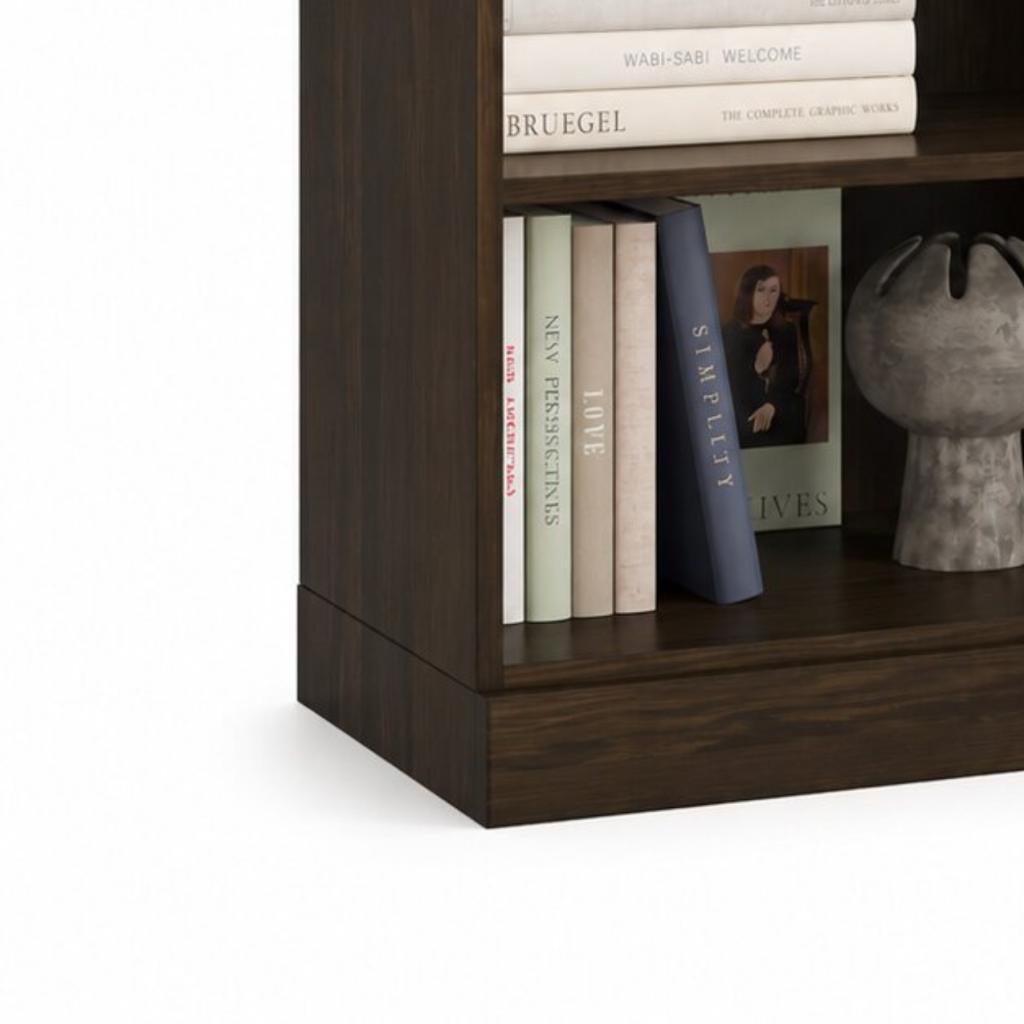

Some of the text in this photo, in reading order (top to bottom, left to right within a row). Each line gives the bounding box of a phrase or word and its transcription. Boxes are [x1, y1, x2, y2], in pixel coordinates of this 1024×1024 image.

[623, 46, 802, 68] WABI-SABI WELCOME
[506, 110, 626, 137] BRUEGEL
[746, 107, 804, 121] COMPLETE
[808, 104, 857, 118] GRAPHIC
[583, 388, 605, 456] LOVE
